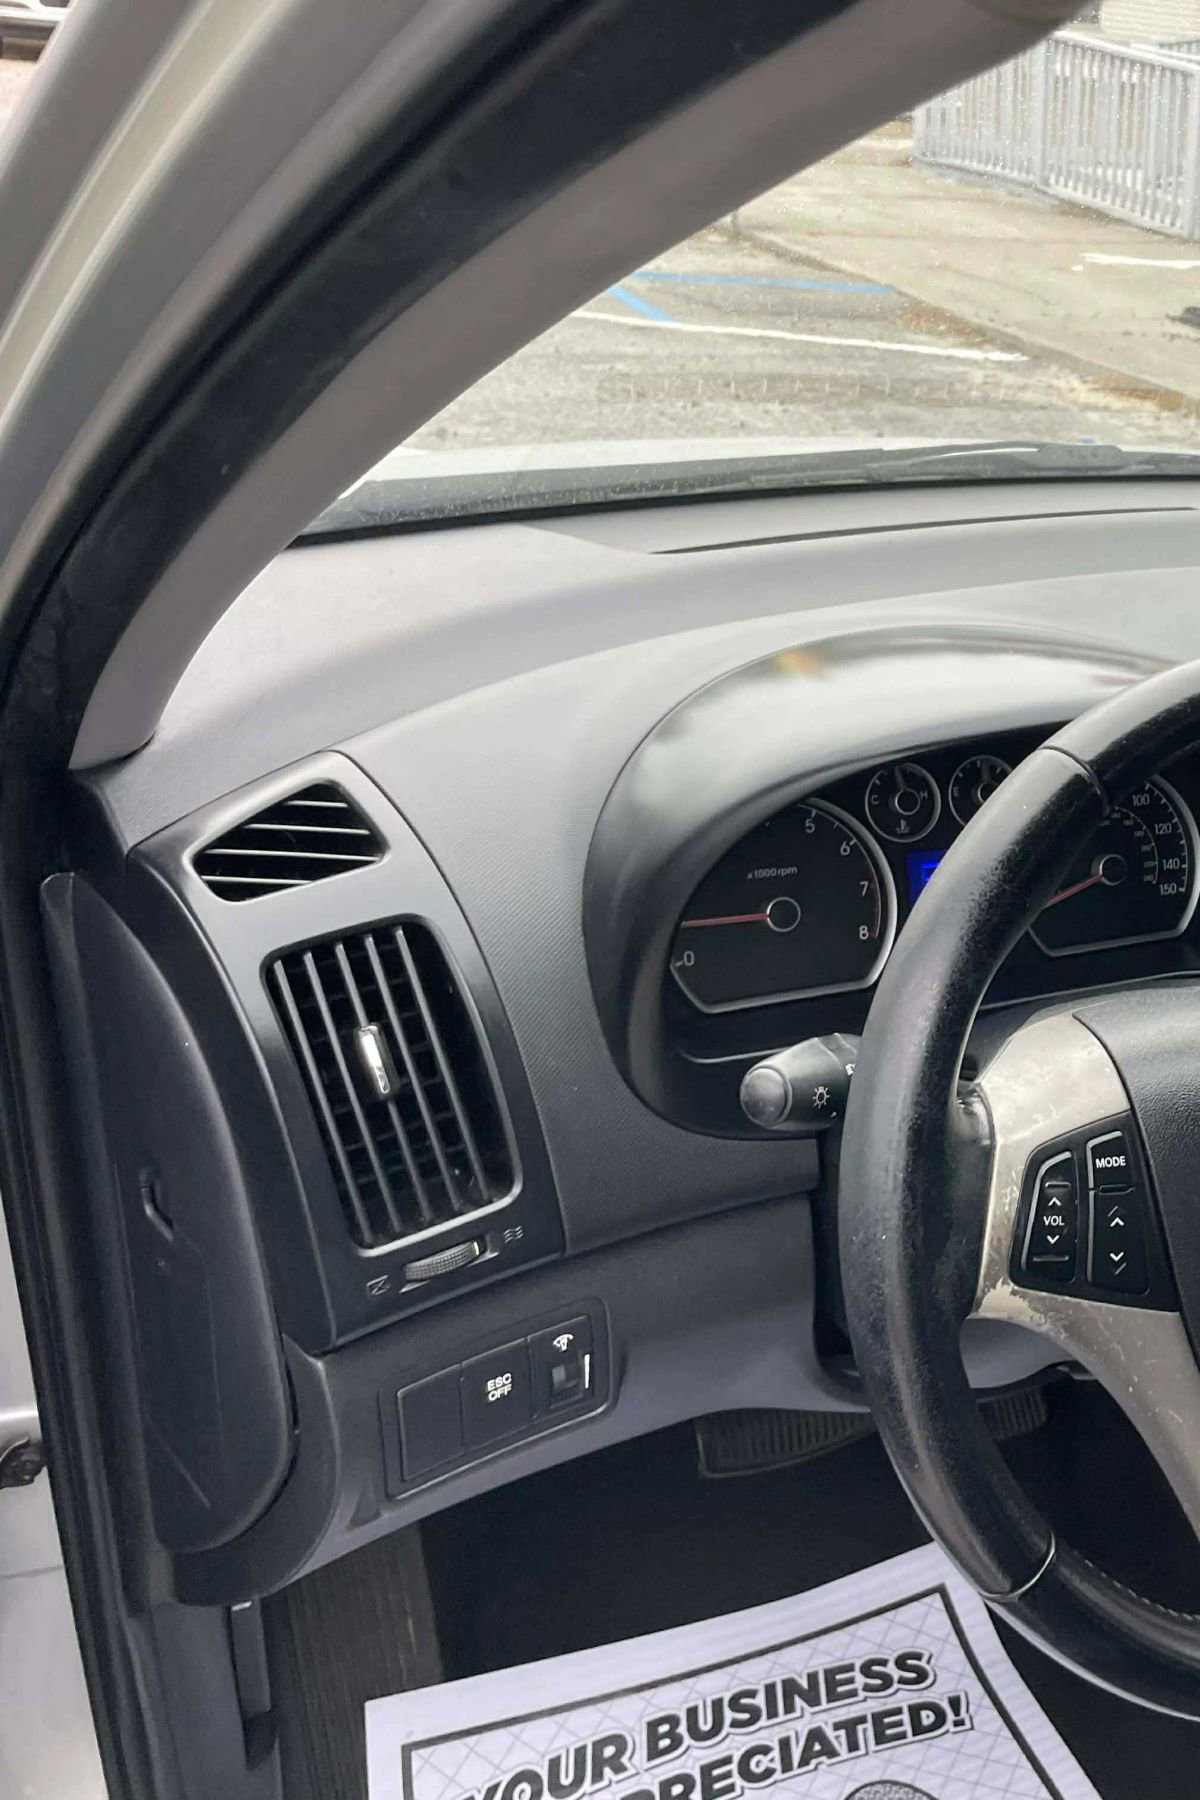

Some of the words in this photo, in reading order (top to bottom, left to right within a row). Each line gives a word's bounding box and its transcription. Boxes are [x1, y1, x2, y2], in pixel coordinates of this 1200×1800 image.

[1131, 793, 1150, 807] 100
[804, 819, 816, 833] 5
[1154, 823, 1172, 836] 120
[840, 840, 850, 856] 6
[1162, 857, 1180, 870] 140
[859, 881, 869, 896] 7
[1159, 883, 1177, 896] 150
[859, 925, 869, 940] 8
[1095, 1155, 1127, 1169] MODE
[1043, 1215, 1065, 1226] VOL
[487, 1372, 513, 1392] ESC
[488, 1384, 513, 1402] OFF
[646, 1650, 931, 1762] BUSINESS
[620, 1695, 967, 1800] RECIATED!
